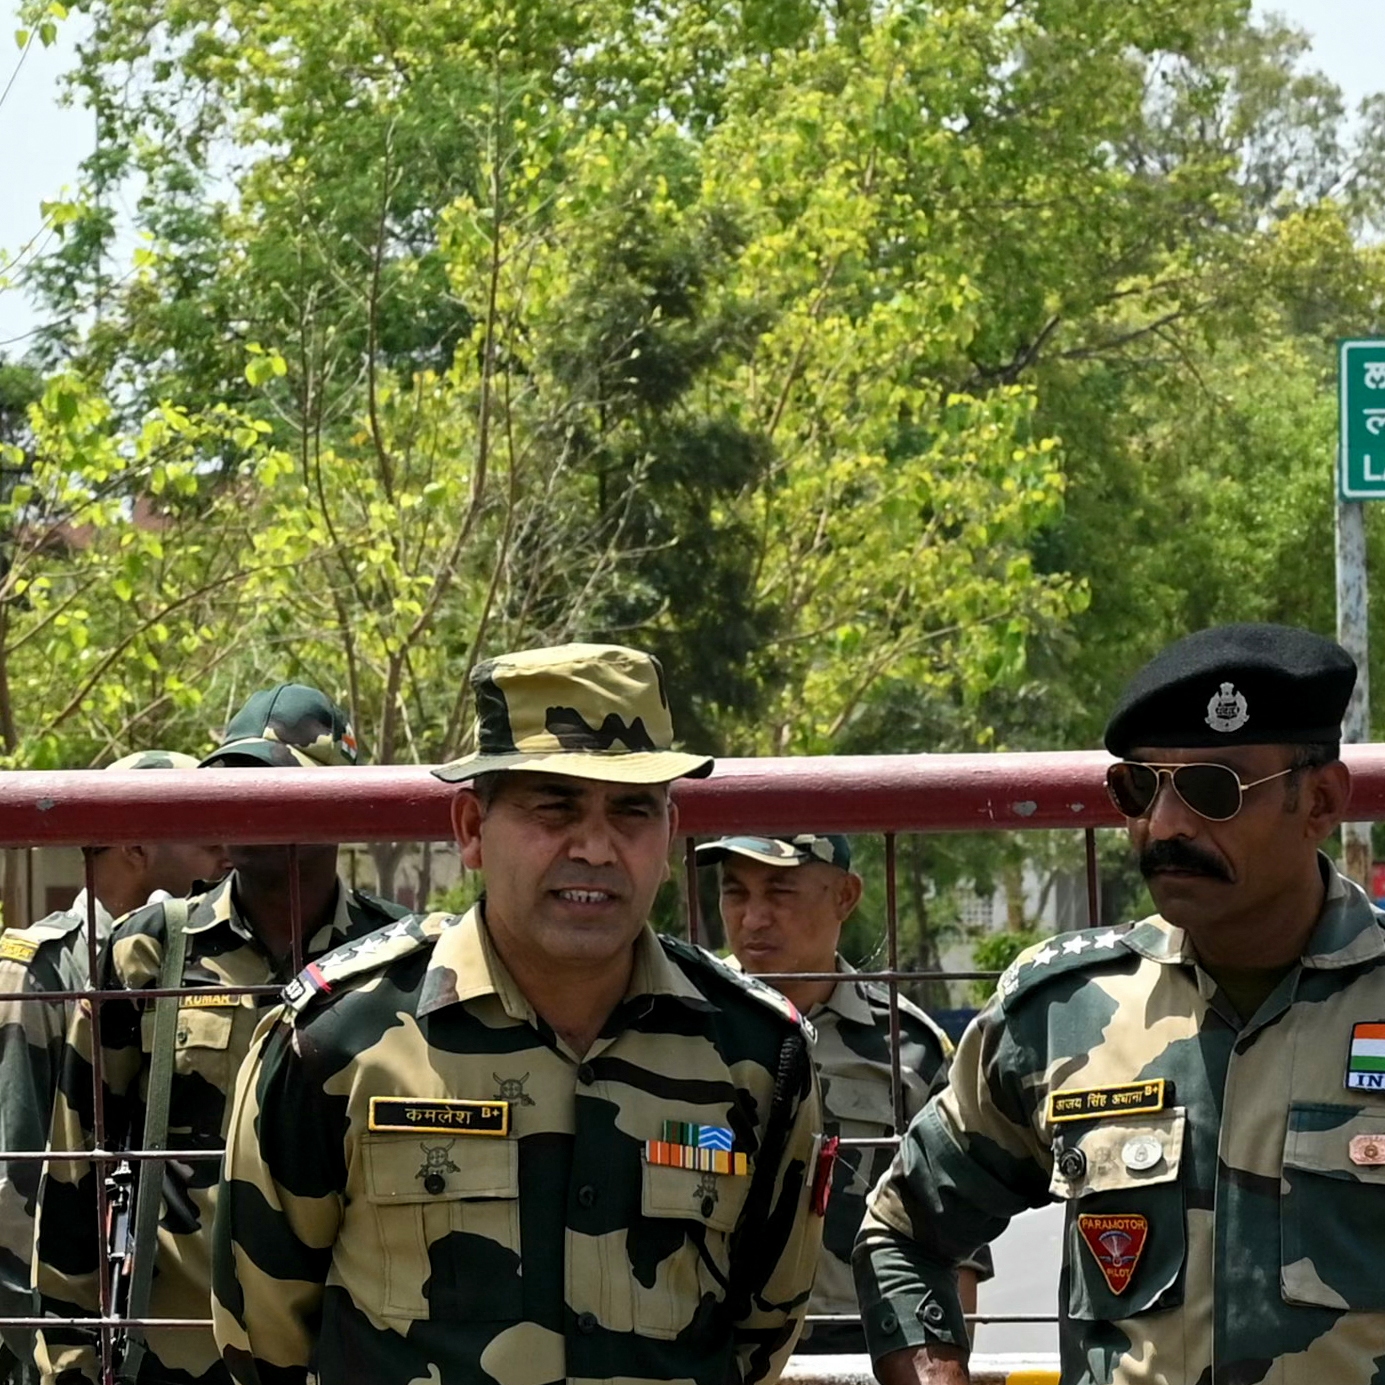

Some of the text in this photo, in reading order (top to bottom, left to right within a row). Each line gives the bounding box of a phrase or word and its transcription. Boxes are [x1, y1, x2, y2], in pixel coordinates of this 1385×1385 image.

[1055, 1097, 1082, 1111] अजय
[1087, 1092, 1108, 1109] सिंह
[404, 1105, 473, 1126] कमलेश
[481, 1106, 501, 1120] B+
[1081, 1218, 1145, 1230] PARAMOTOR
[1106, 1268, 1130, 1278] PILOT
